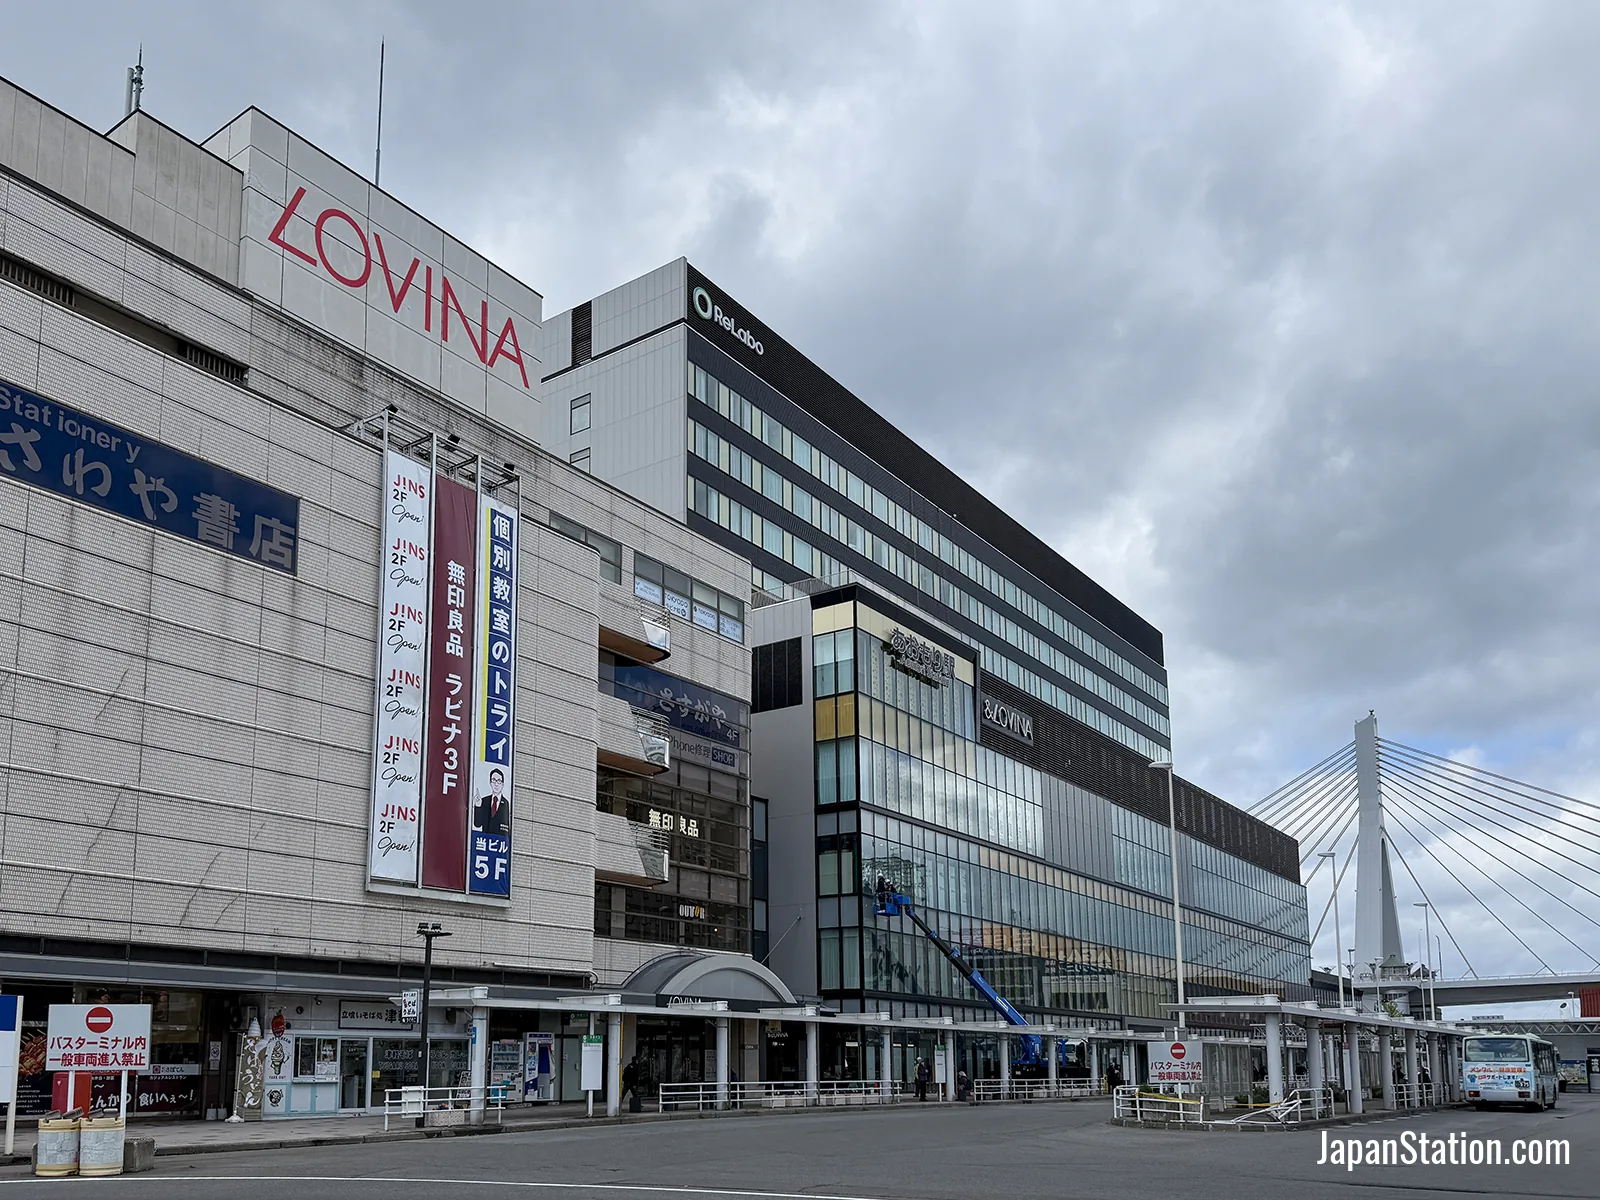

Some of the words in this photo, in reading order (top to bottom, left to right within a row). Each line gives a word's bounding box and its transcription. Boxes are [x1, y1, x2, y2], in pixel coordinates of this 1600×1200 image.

[268, 186, 529, 389] LOVINA
[714, 305, 764, 355] ReLabo
[0, 422, 296, 568] さわや書店
[393, 489, 407, 502] 2F
[392, 505, 424, 525] Open!
[391, 553, 407, 566] 2F
[390, 568, 424, 587] Open!
[446, 560, 465, 658] 無印良品
[388, 619, 405, 631] 2F
[387, 634, 422, 653] Open!
[490, 513, 511, 760] 個別教室のトライ
[386, 685, 403, 697] 2F
[385, 700, 420, 720] Open!
[985, 700, 1033, 740] &LOVINA
[443, 673, 463, 794] ラビナ3F
[727, 729, 738, 740] 4F
[383, 752, 400, 765] 2F
[713, 750, 734, 764] SHOP
[381, 767, 417, 788] Open!
[379, 821, 395, 834] 2F
[649, 809, 698, 837] 無印良品
[378, 836, 415, 857] Open!
[476, 837, 508, 853] 当ビル
[475, 856, 507, 880] 5F
[50, 1036, 146, 1050] バスターミナル内
[49, 1052, 146, 1067] 一般車両進入禁止
[1151, 1062, 1201, 1070] バスターミナル内
[1151, 1071, 1201, 1081] 一般車両進入禁止
